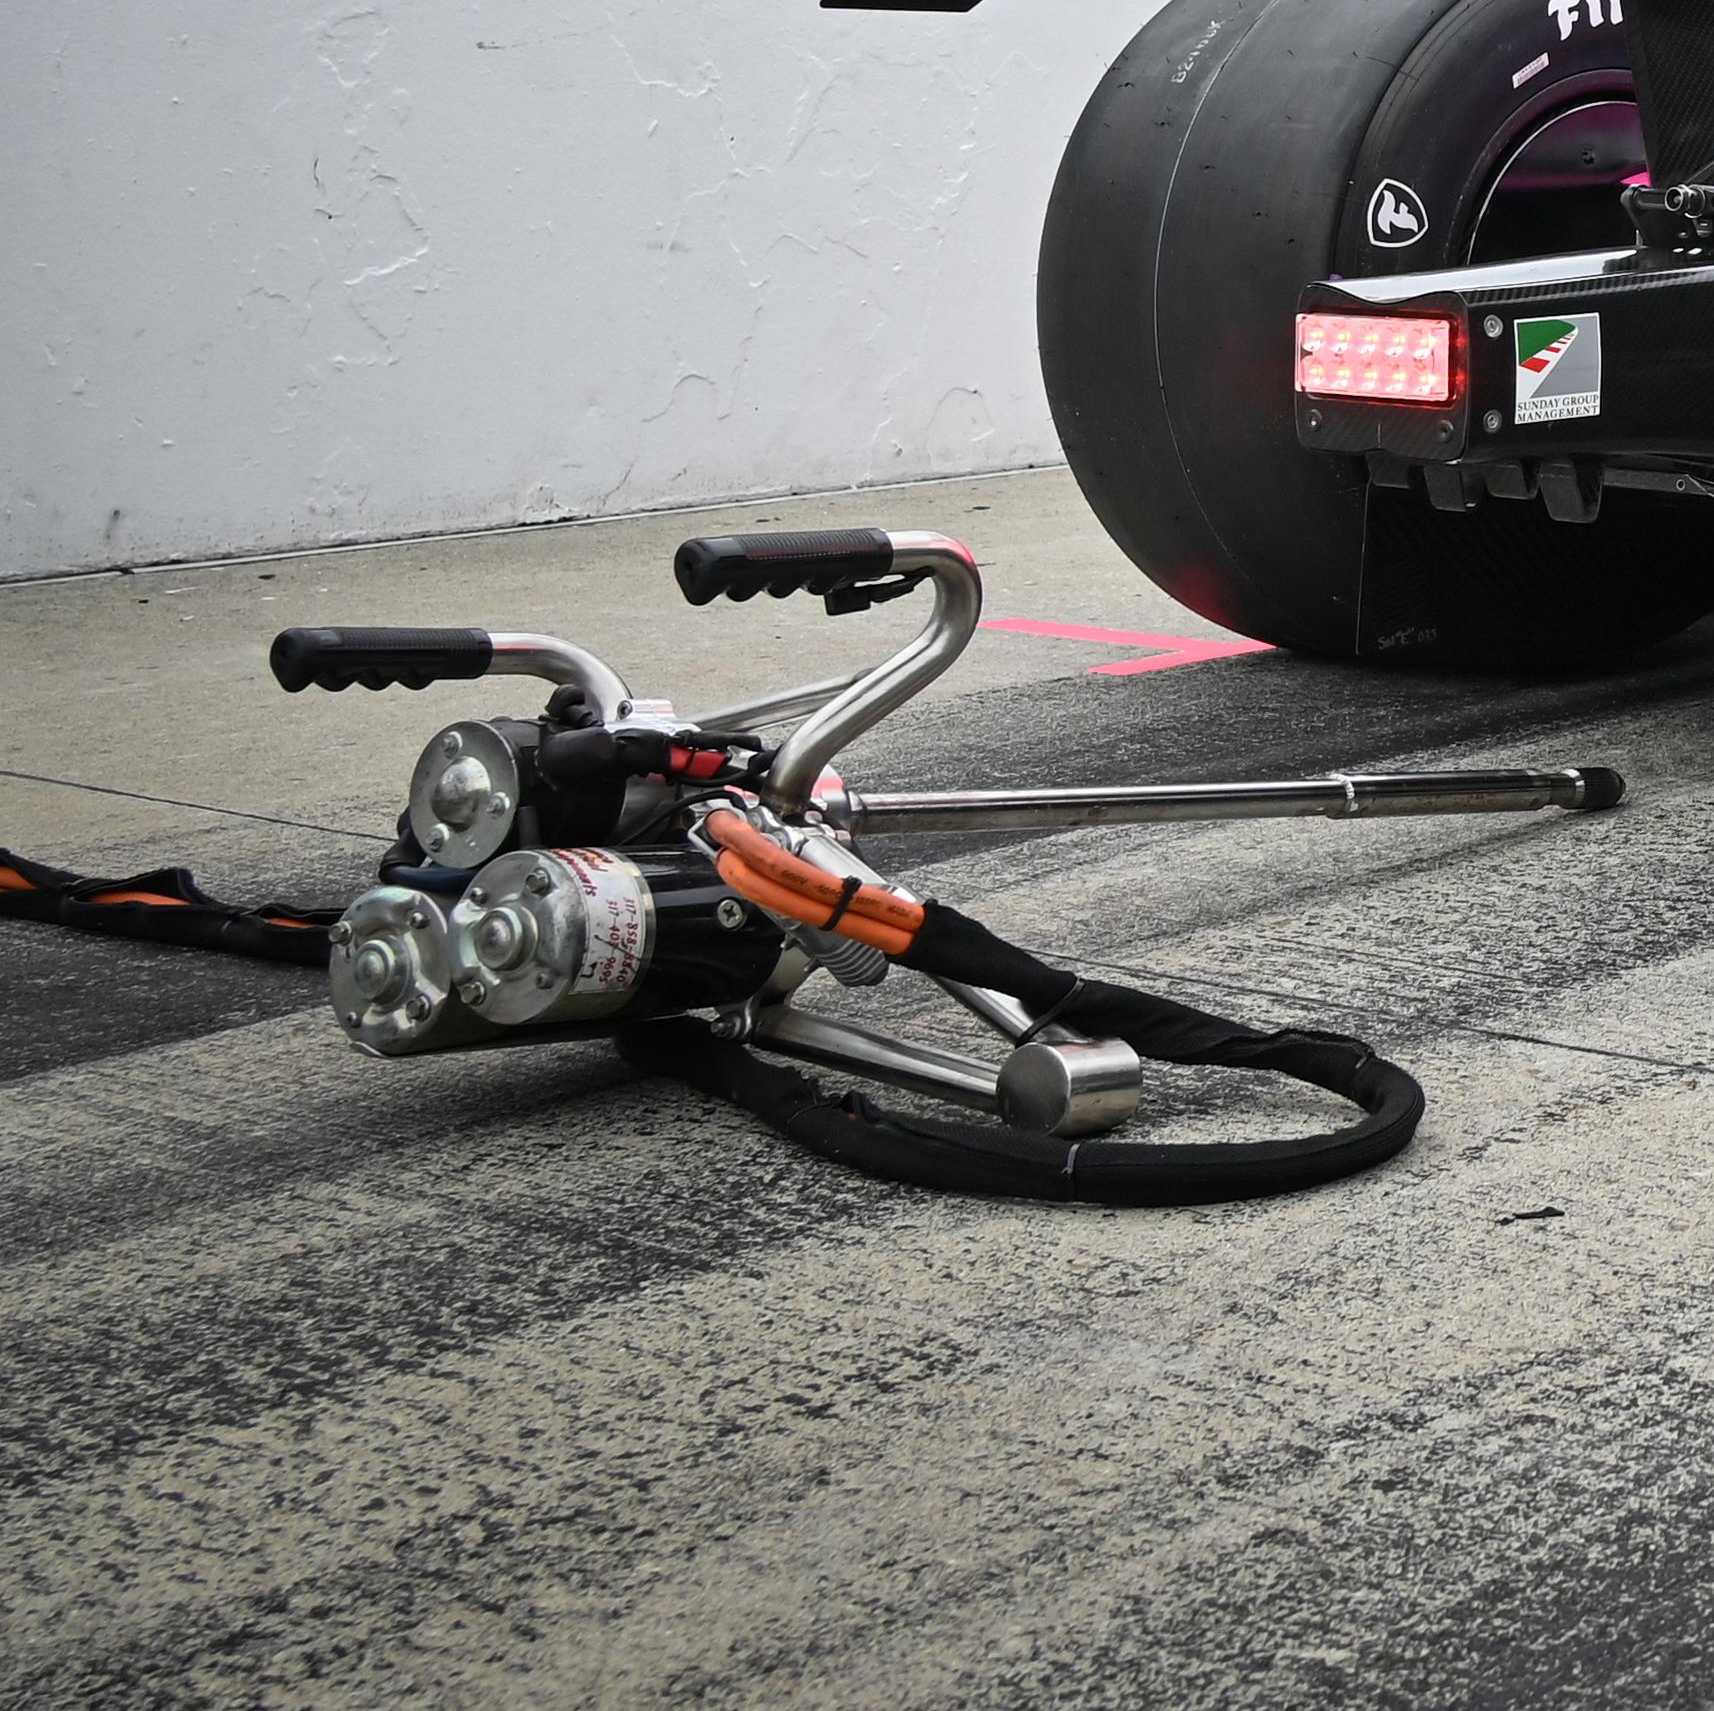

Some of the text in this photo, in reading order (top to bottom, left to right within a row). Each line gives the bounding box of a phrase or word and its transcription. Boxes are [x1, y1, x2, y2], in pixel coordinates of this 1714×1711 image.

[1517, 393, 1599, 412] SUNDAY GROUP
[1517, 405, 1599, 423] MANAGEMENT
